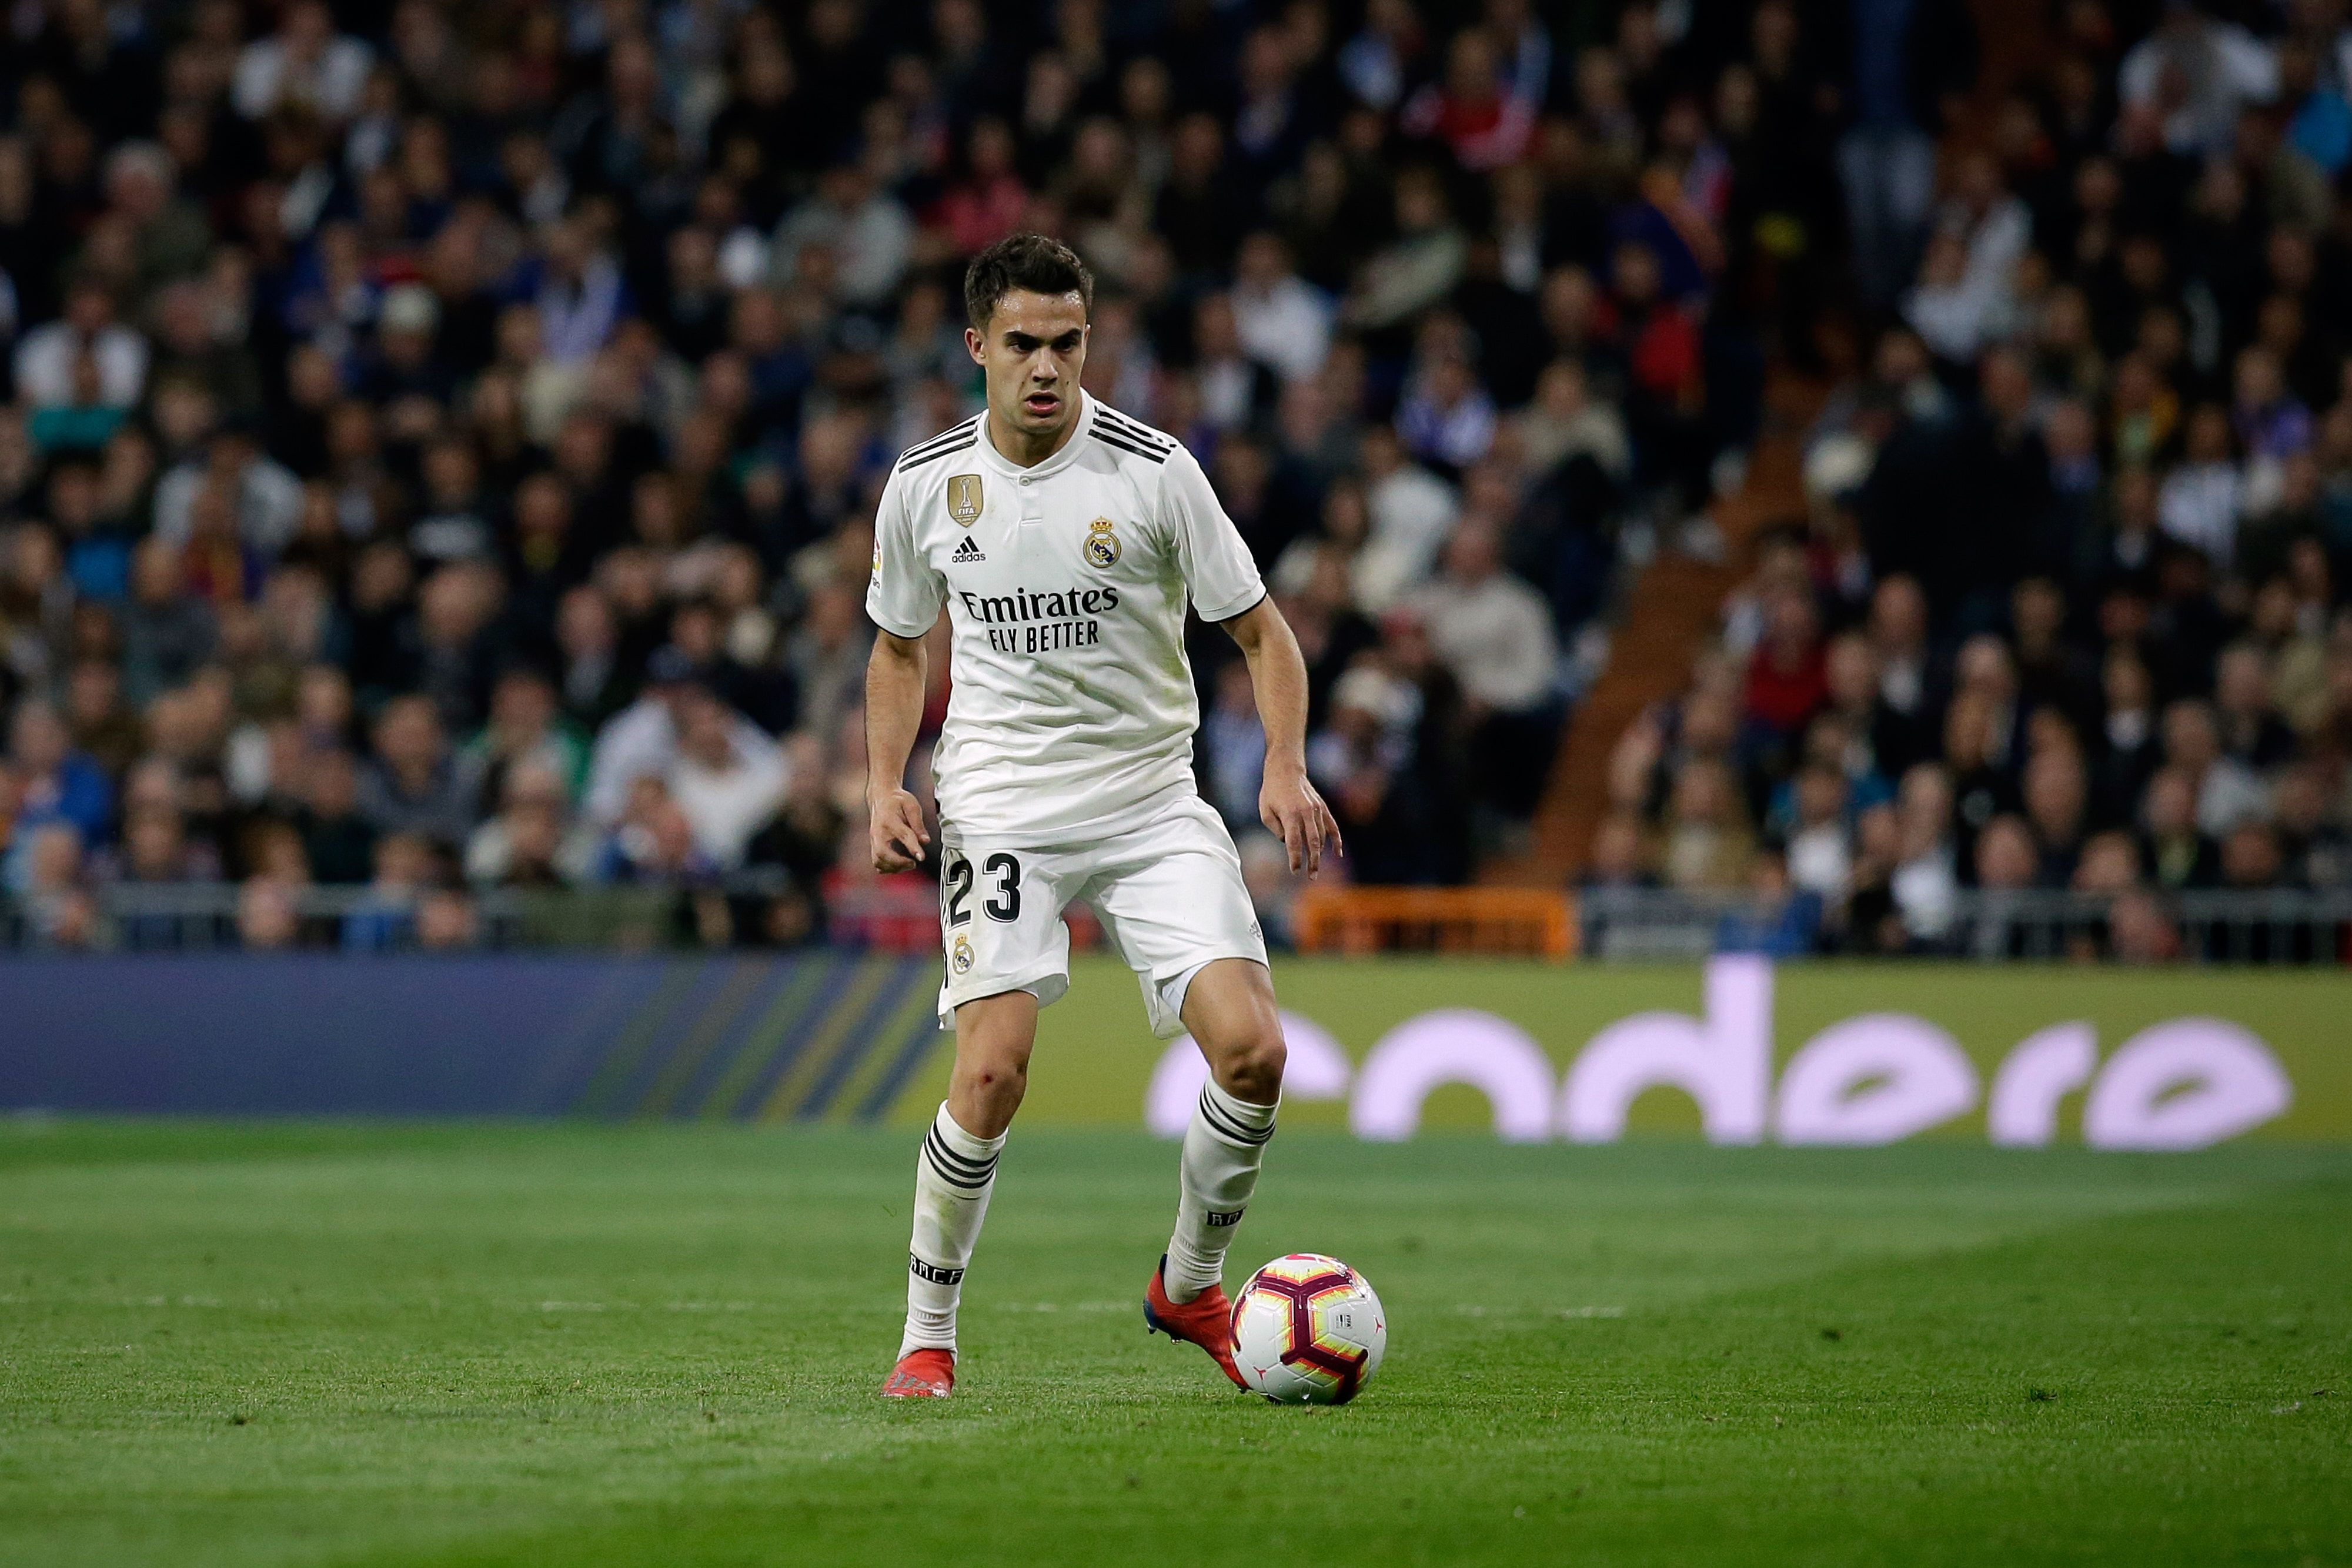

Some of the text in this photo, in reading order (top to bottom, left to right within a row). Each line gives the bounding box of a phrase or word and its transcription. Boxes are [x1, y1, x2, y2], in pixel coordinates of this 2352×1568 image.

[951, 553, 986, 563] adidas
[959, 587, 1119, 623] Emirates
[989, 620, 1099, 653] FLY BETTER
[946, 852, 1021, 931] 23
[910, 1253, 963, 1285] RMCF
